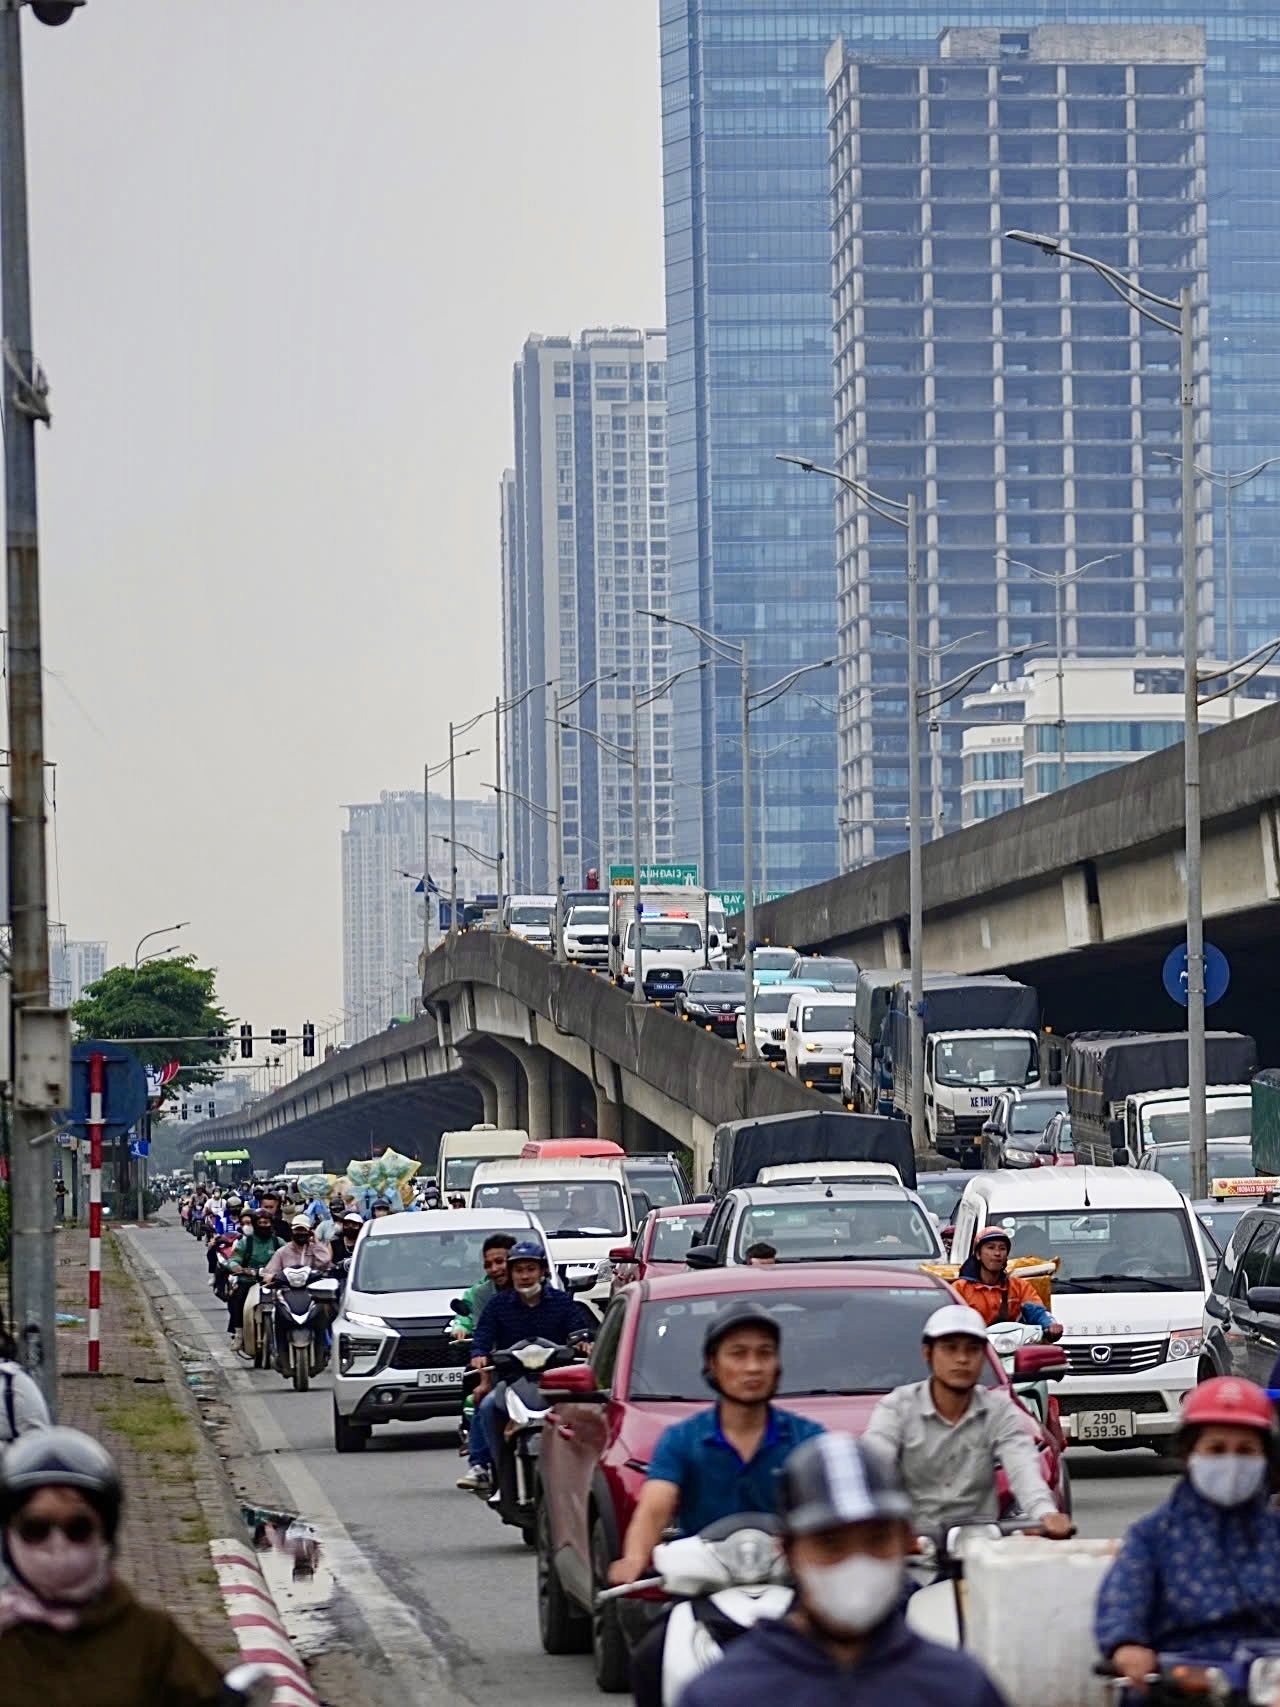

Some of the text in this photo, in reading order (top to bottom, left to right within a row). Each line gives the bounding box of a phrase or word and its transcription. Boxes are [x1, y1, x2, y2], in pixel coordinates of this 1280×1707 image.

[676, 869, 682, 878] 3
[723, 895, 741, 904] BAY
[1093, 1412, 1117, 1425] 29D
[1083, 1425, 1127, 1438] 539.36
